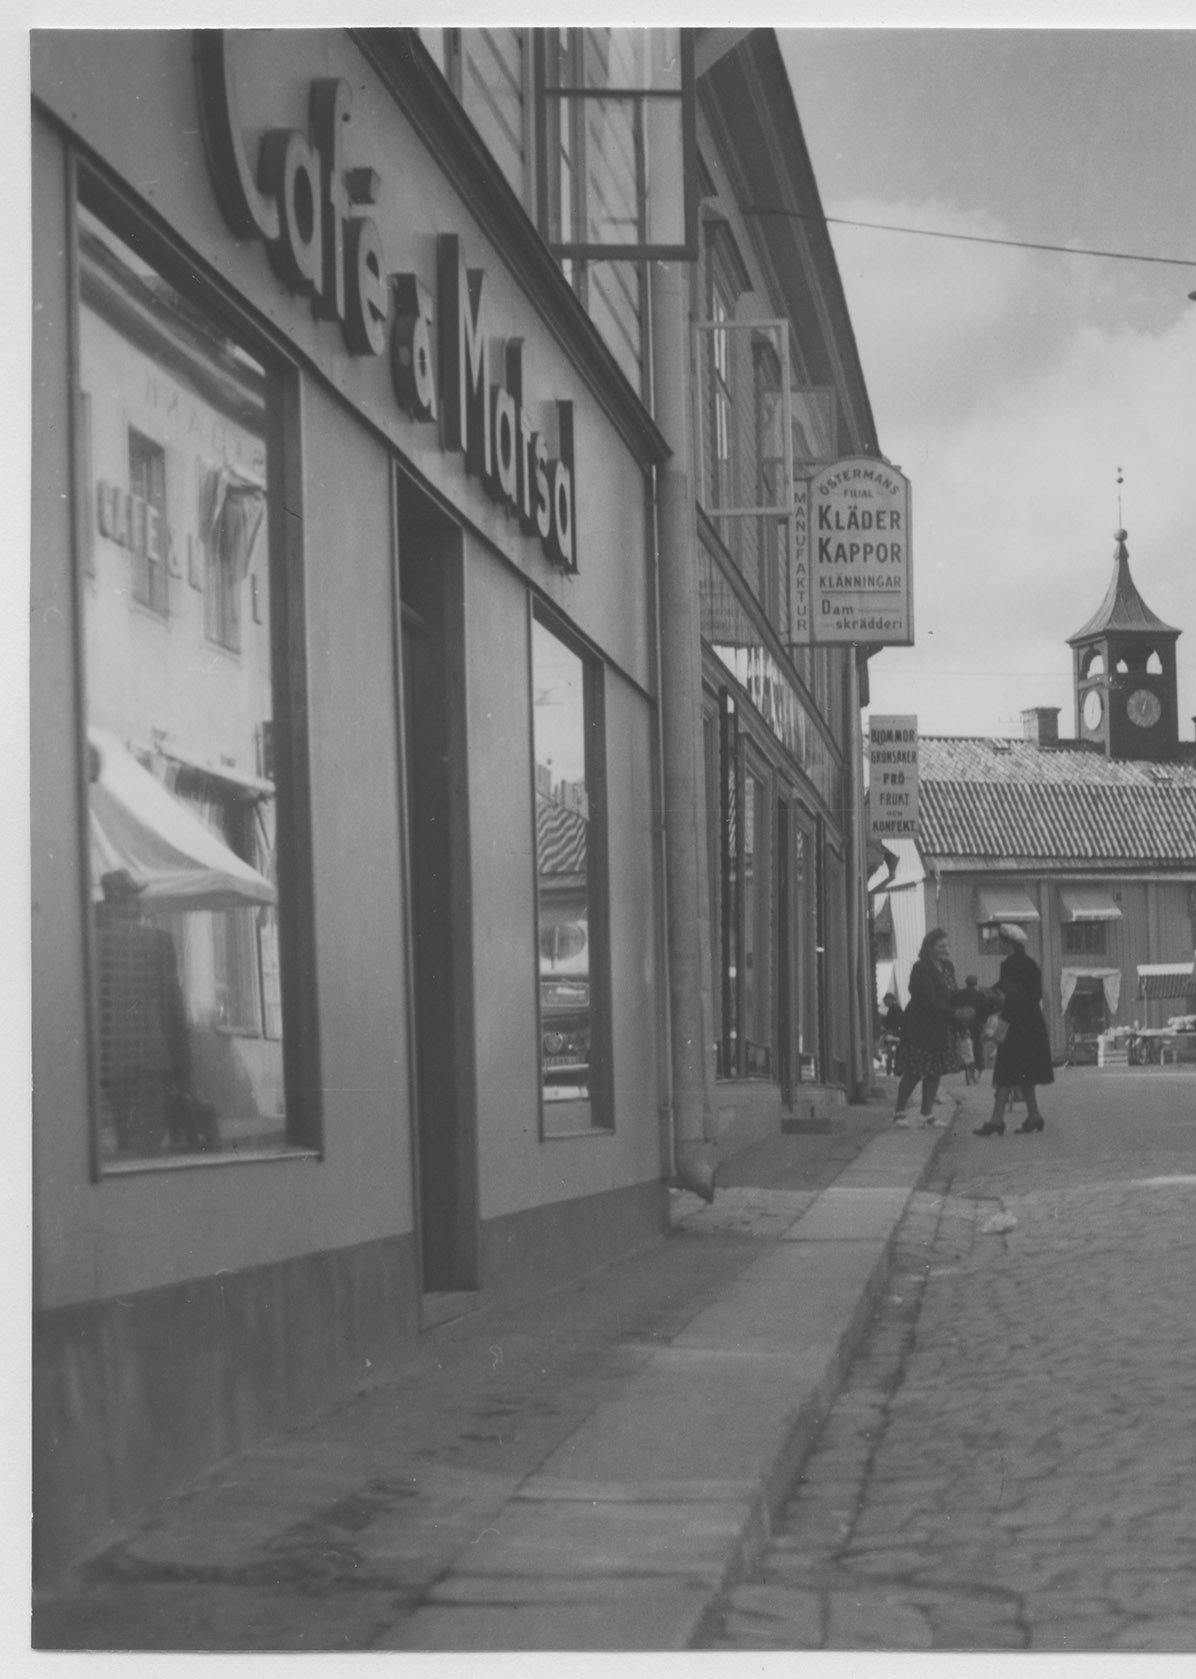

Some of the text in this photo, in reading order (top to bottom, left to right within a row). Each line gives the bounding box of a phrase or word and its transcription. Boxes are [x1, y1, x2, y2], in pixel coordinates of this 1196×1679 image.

[818, 468, 900, 497] ÖSTERMANS
[843, 488, 874, 499] FILIAL
[818, 504, 902, 531] KLÄDER
[818, 537, 902, 564] KAPPOR
[794, 492, 807, 632] MANUFAKTUR
[819, 572, 902, 590] KLÄNNINGAR
[821, 598, 854, 616] Dam
[880, 792, 910, 806] FRUKT
